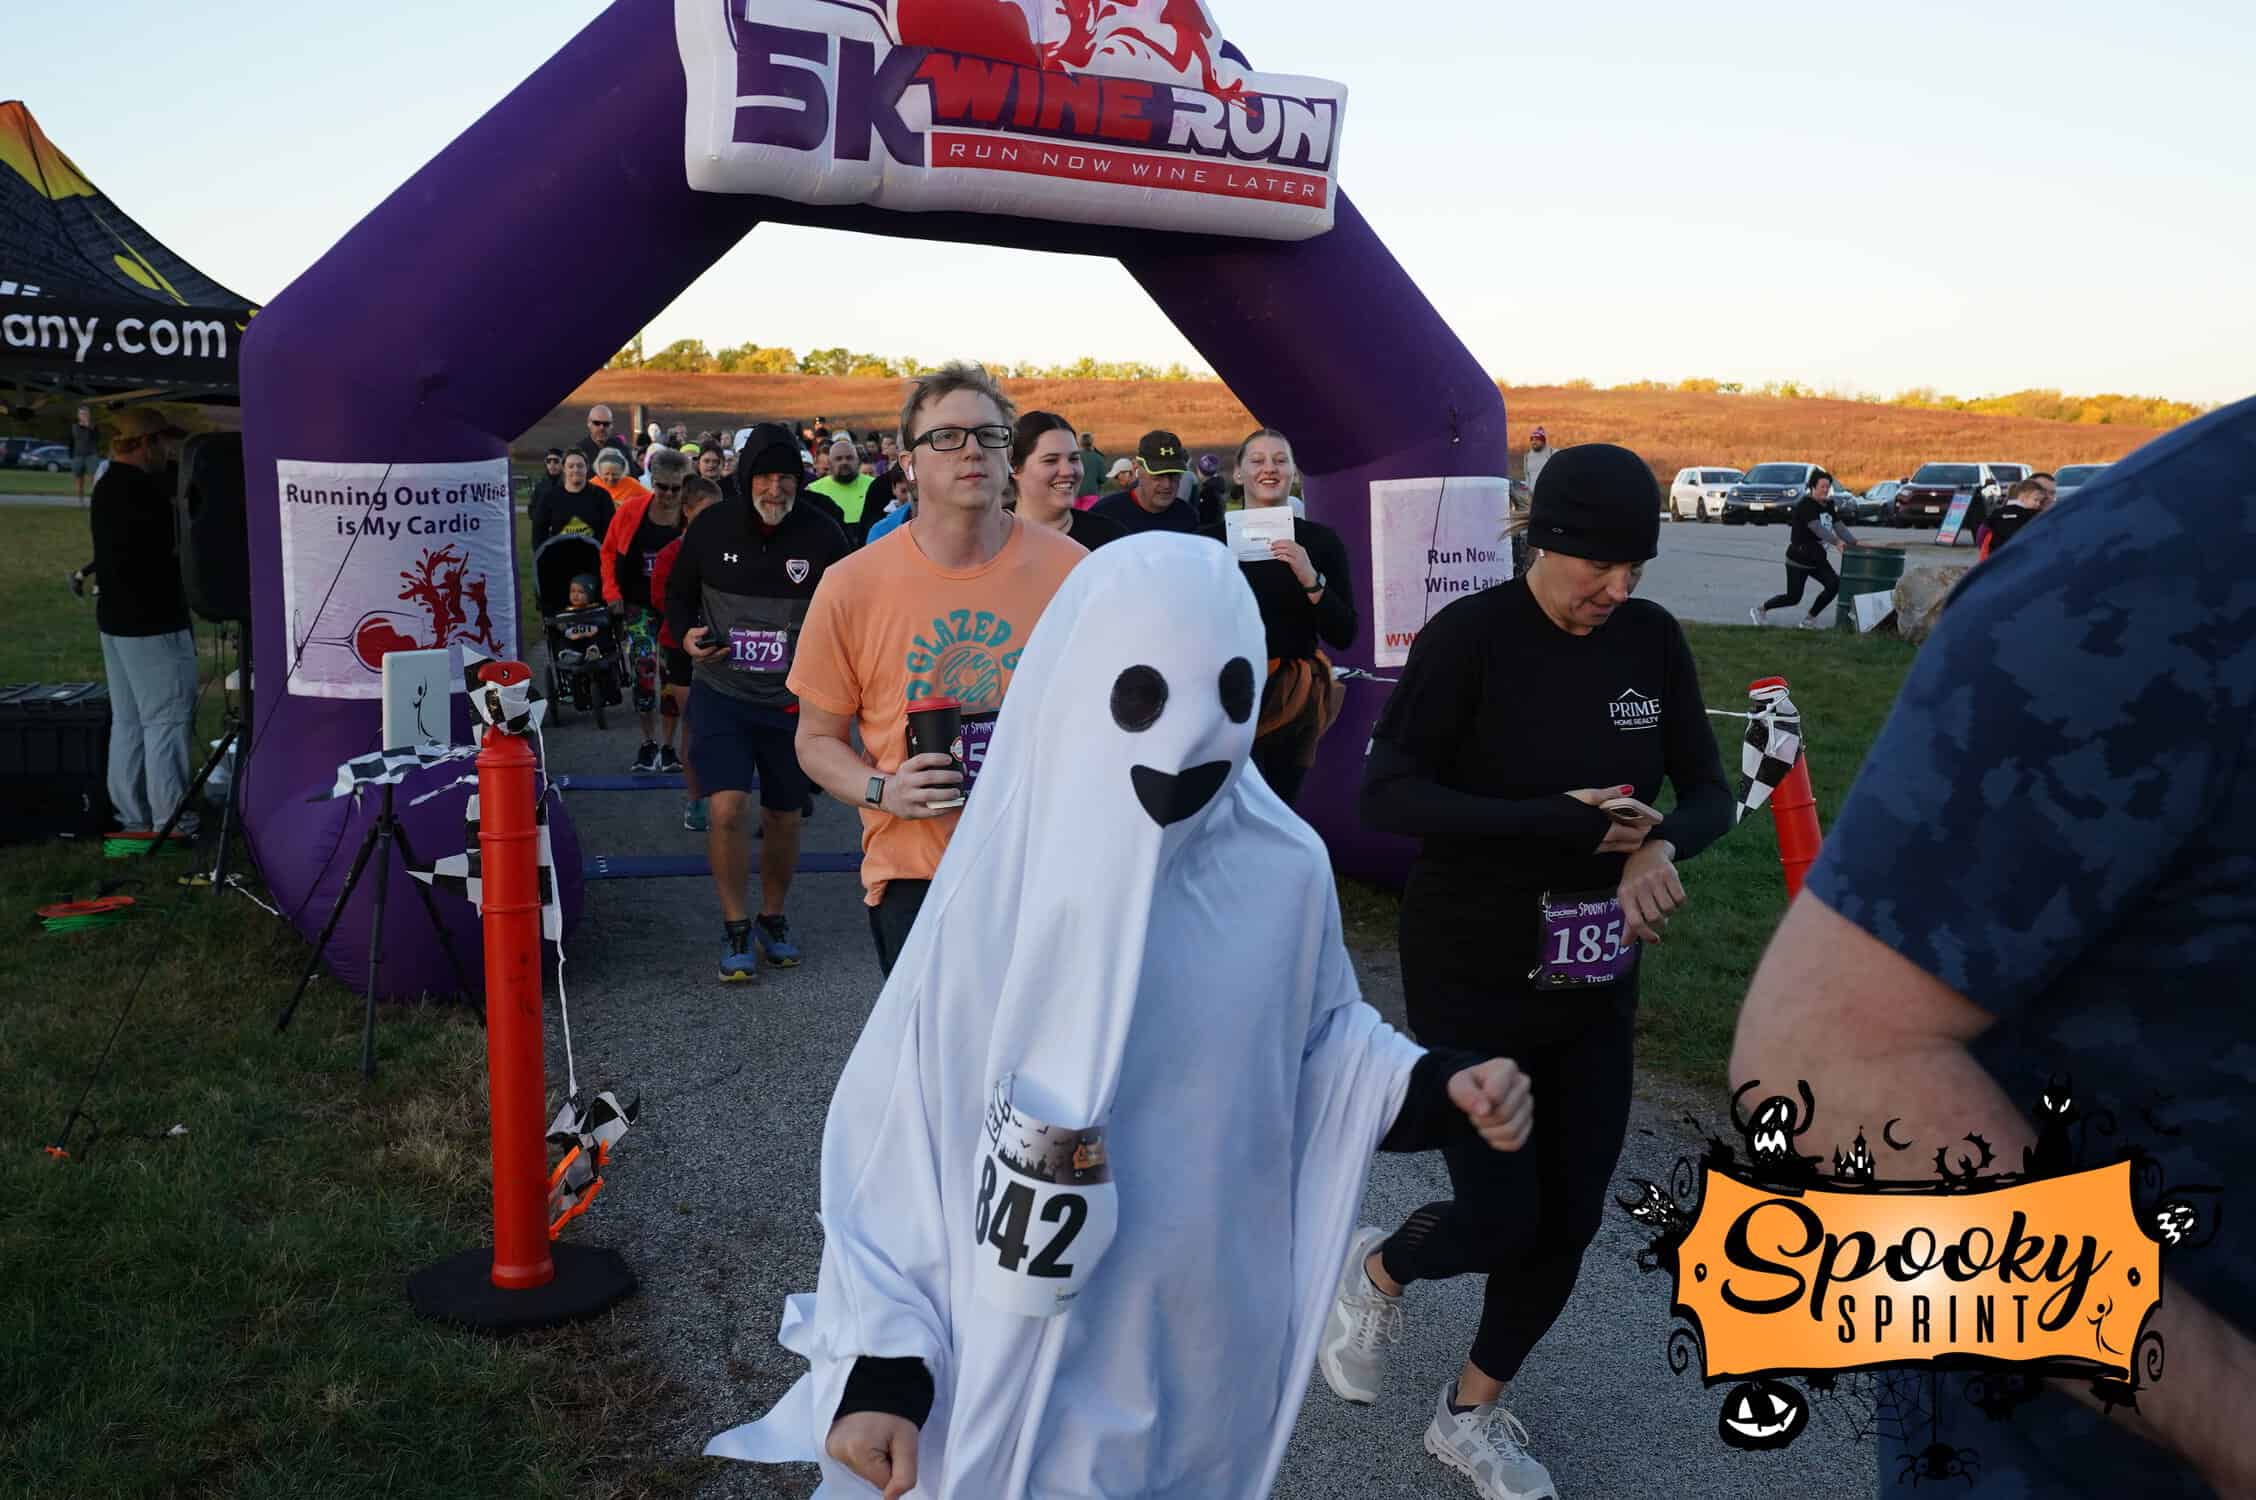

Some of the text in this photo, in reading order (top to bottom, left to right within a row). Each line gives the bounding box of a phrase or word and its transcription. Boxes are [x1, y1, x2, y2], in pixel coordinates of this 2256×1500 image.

[732, 20, 1335, 167] 5K WINE RUN
[950, 143, 1316, 197] RUN NOW WINE LATER
[286, 483, 388, 511] Running
[394, 486, 441, 506] Out
[446, 484, 467, 504] of
[337, 513, 480, 541] is My Cardio
[1427, 549, 1462, 564] Run
[1425, 575, 1470, 593] Wine
[732, 640, 784, 662] 1879
[906, 608, 1013, 673] GLAZED
[1608, 698, 1661, 718] PRIME
[1551, 919, 1630, 965] 185
[975, 1154, 1089, 1279] 842
